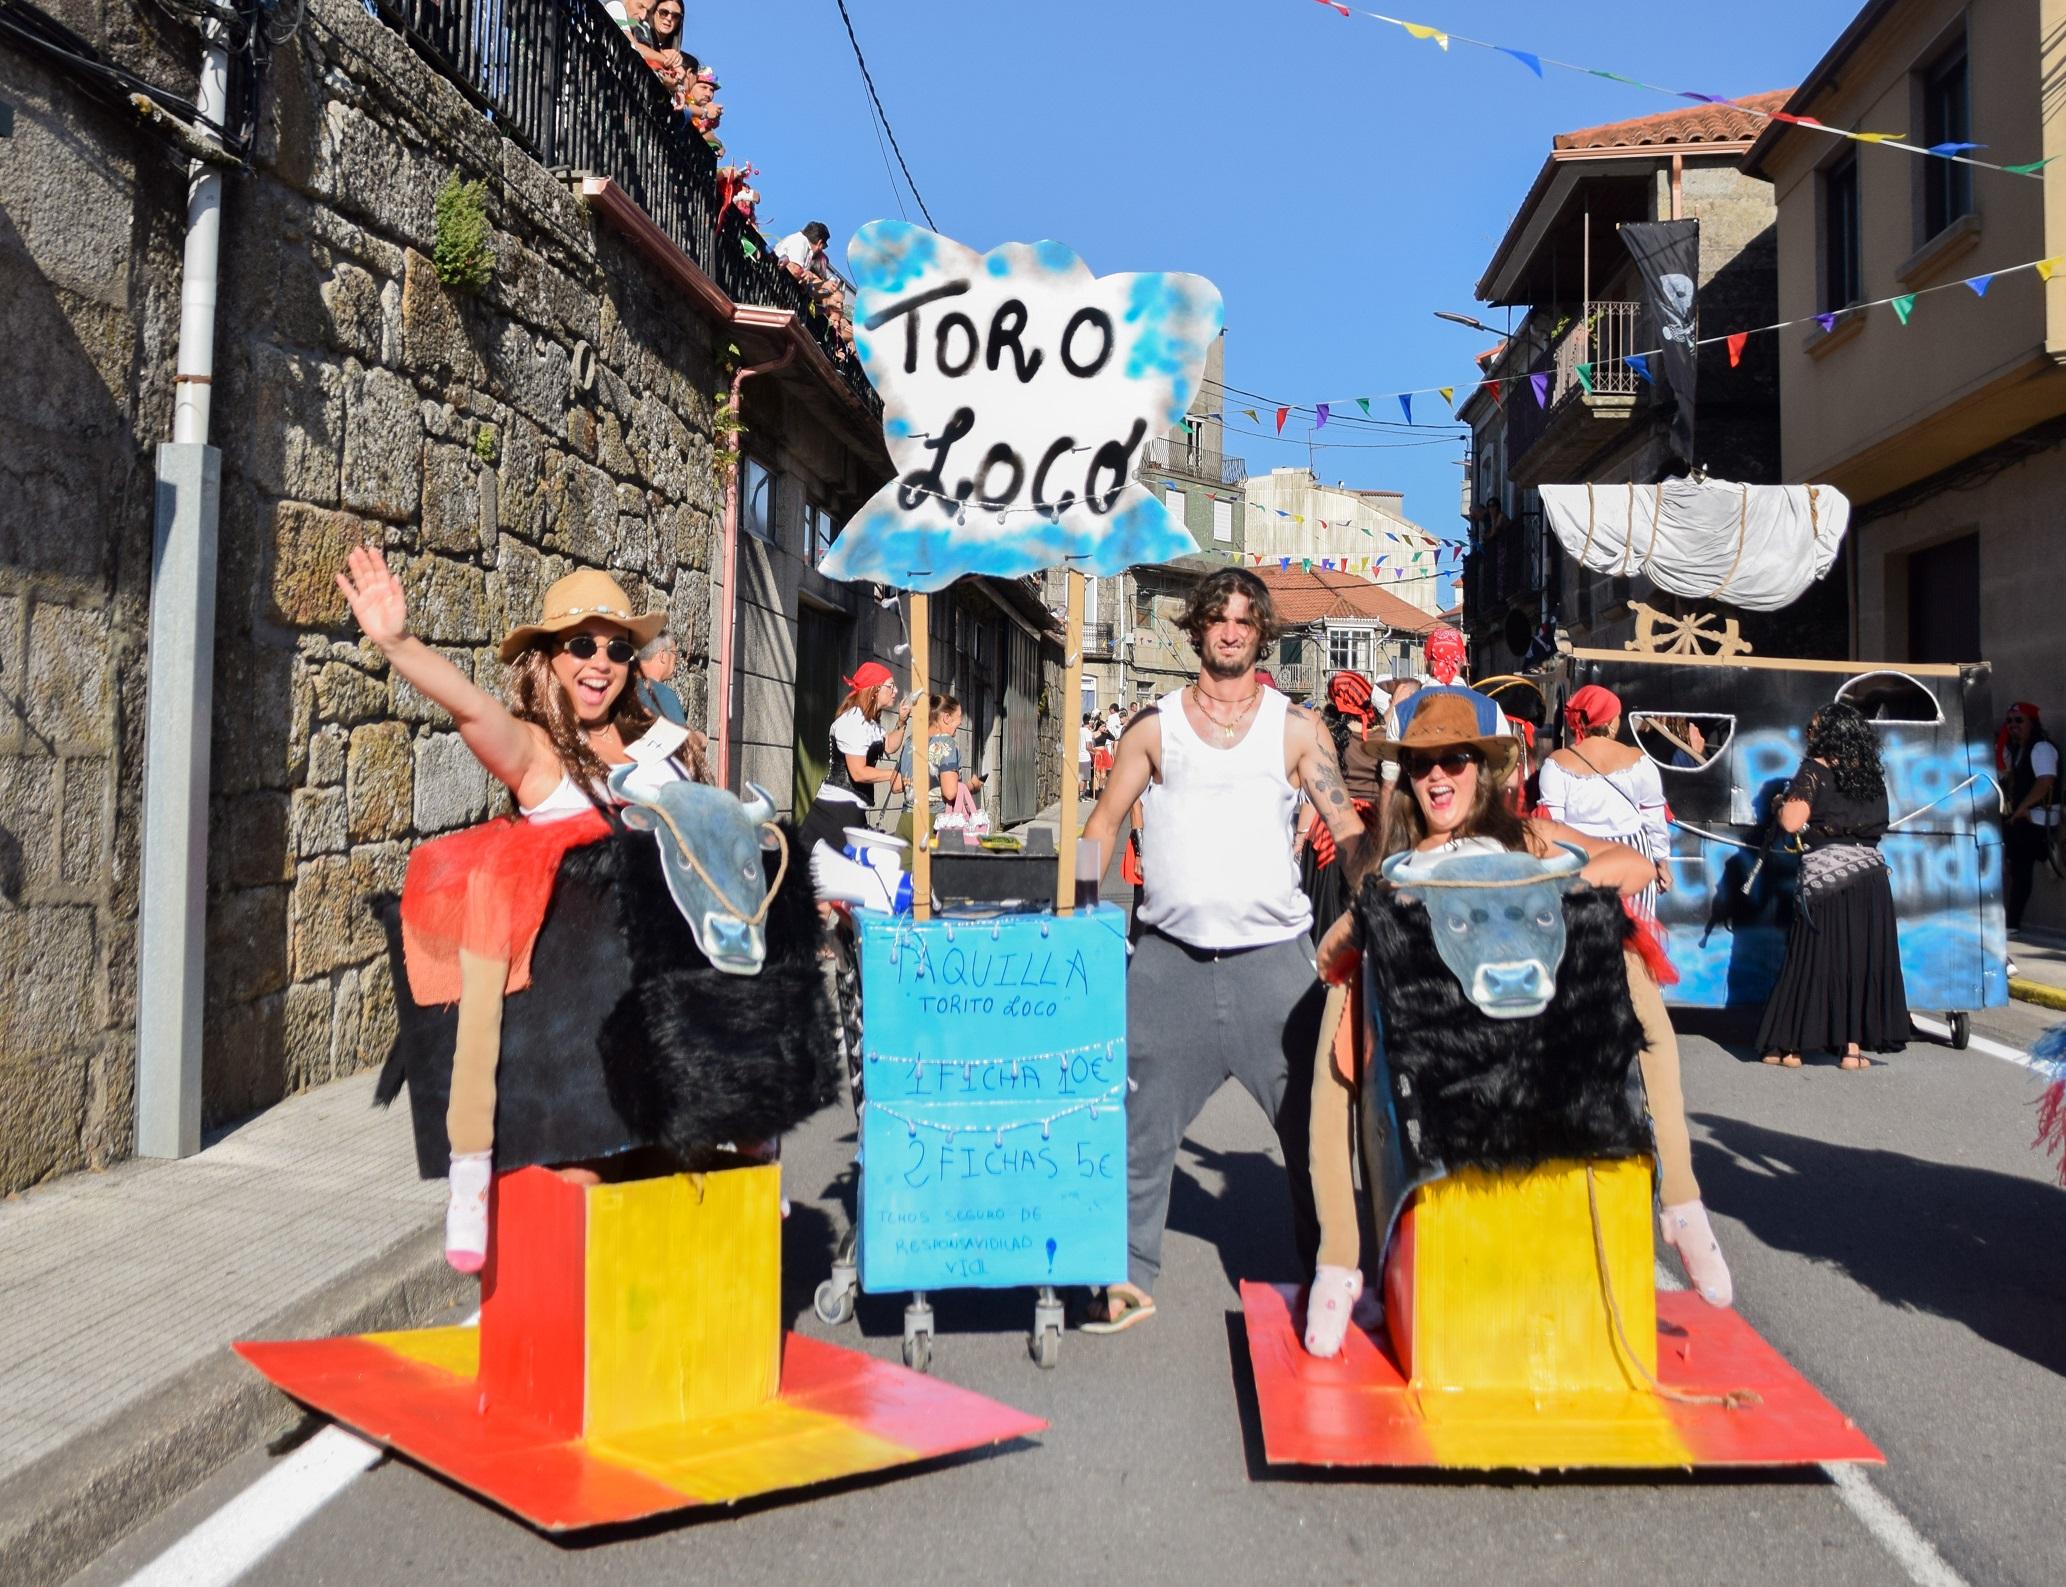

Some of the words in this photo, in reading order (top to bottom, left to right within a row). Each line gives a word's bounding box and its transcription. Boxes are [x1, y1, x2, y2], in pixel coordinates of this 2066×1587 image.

[865, 278, 1115, 383] TORO
[897, 406, 1148, 517] LOCO
[1002, 995, 1058, 1017] LOCO
[905, 1051, 933, 1094] 1
[938, 1060, 1041, 1093] FICHA
[1057, 1053, 1110, 1094] 10€
[903, 1140, 930, 1188] 2
[940, 1146, 1058, 1182] FICHAS
[1076, 1141, 1114, 1178] 5€
[1020, 1206, 1042, 1223] DE
